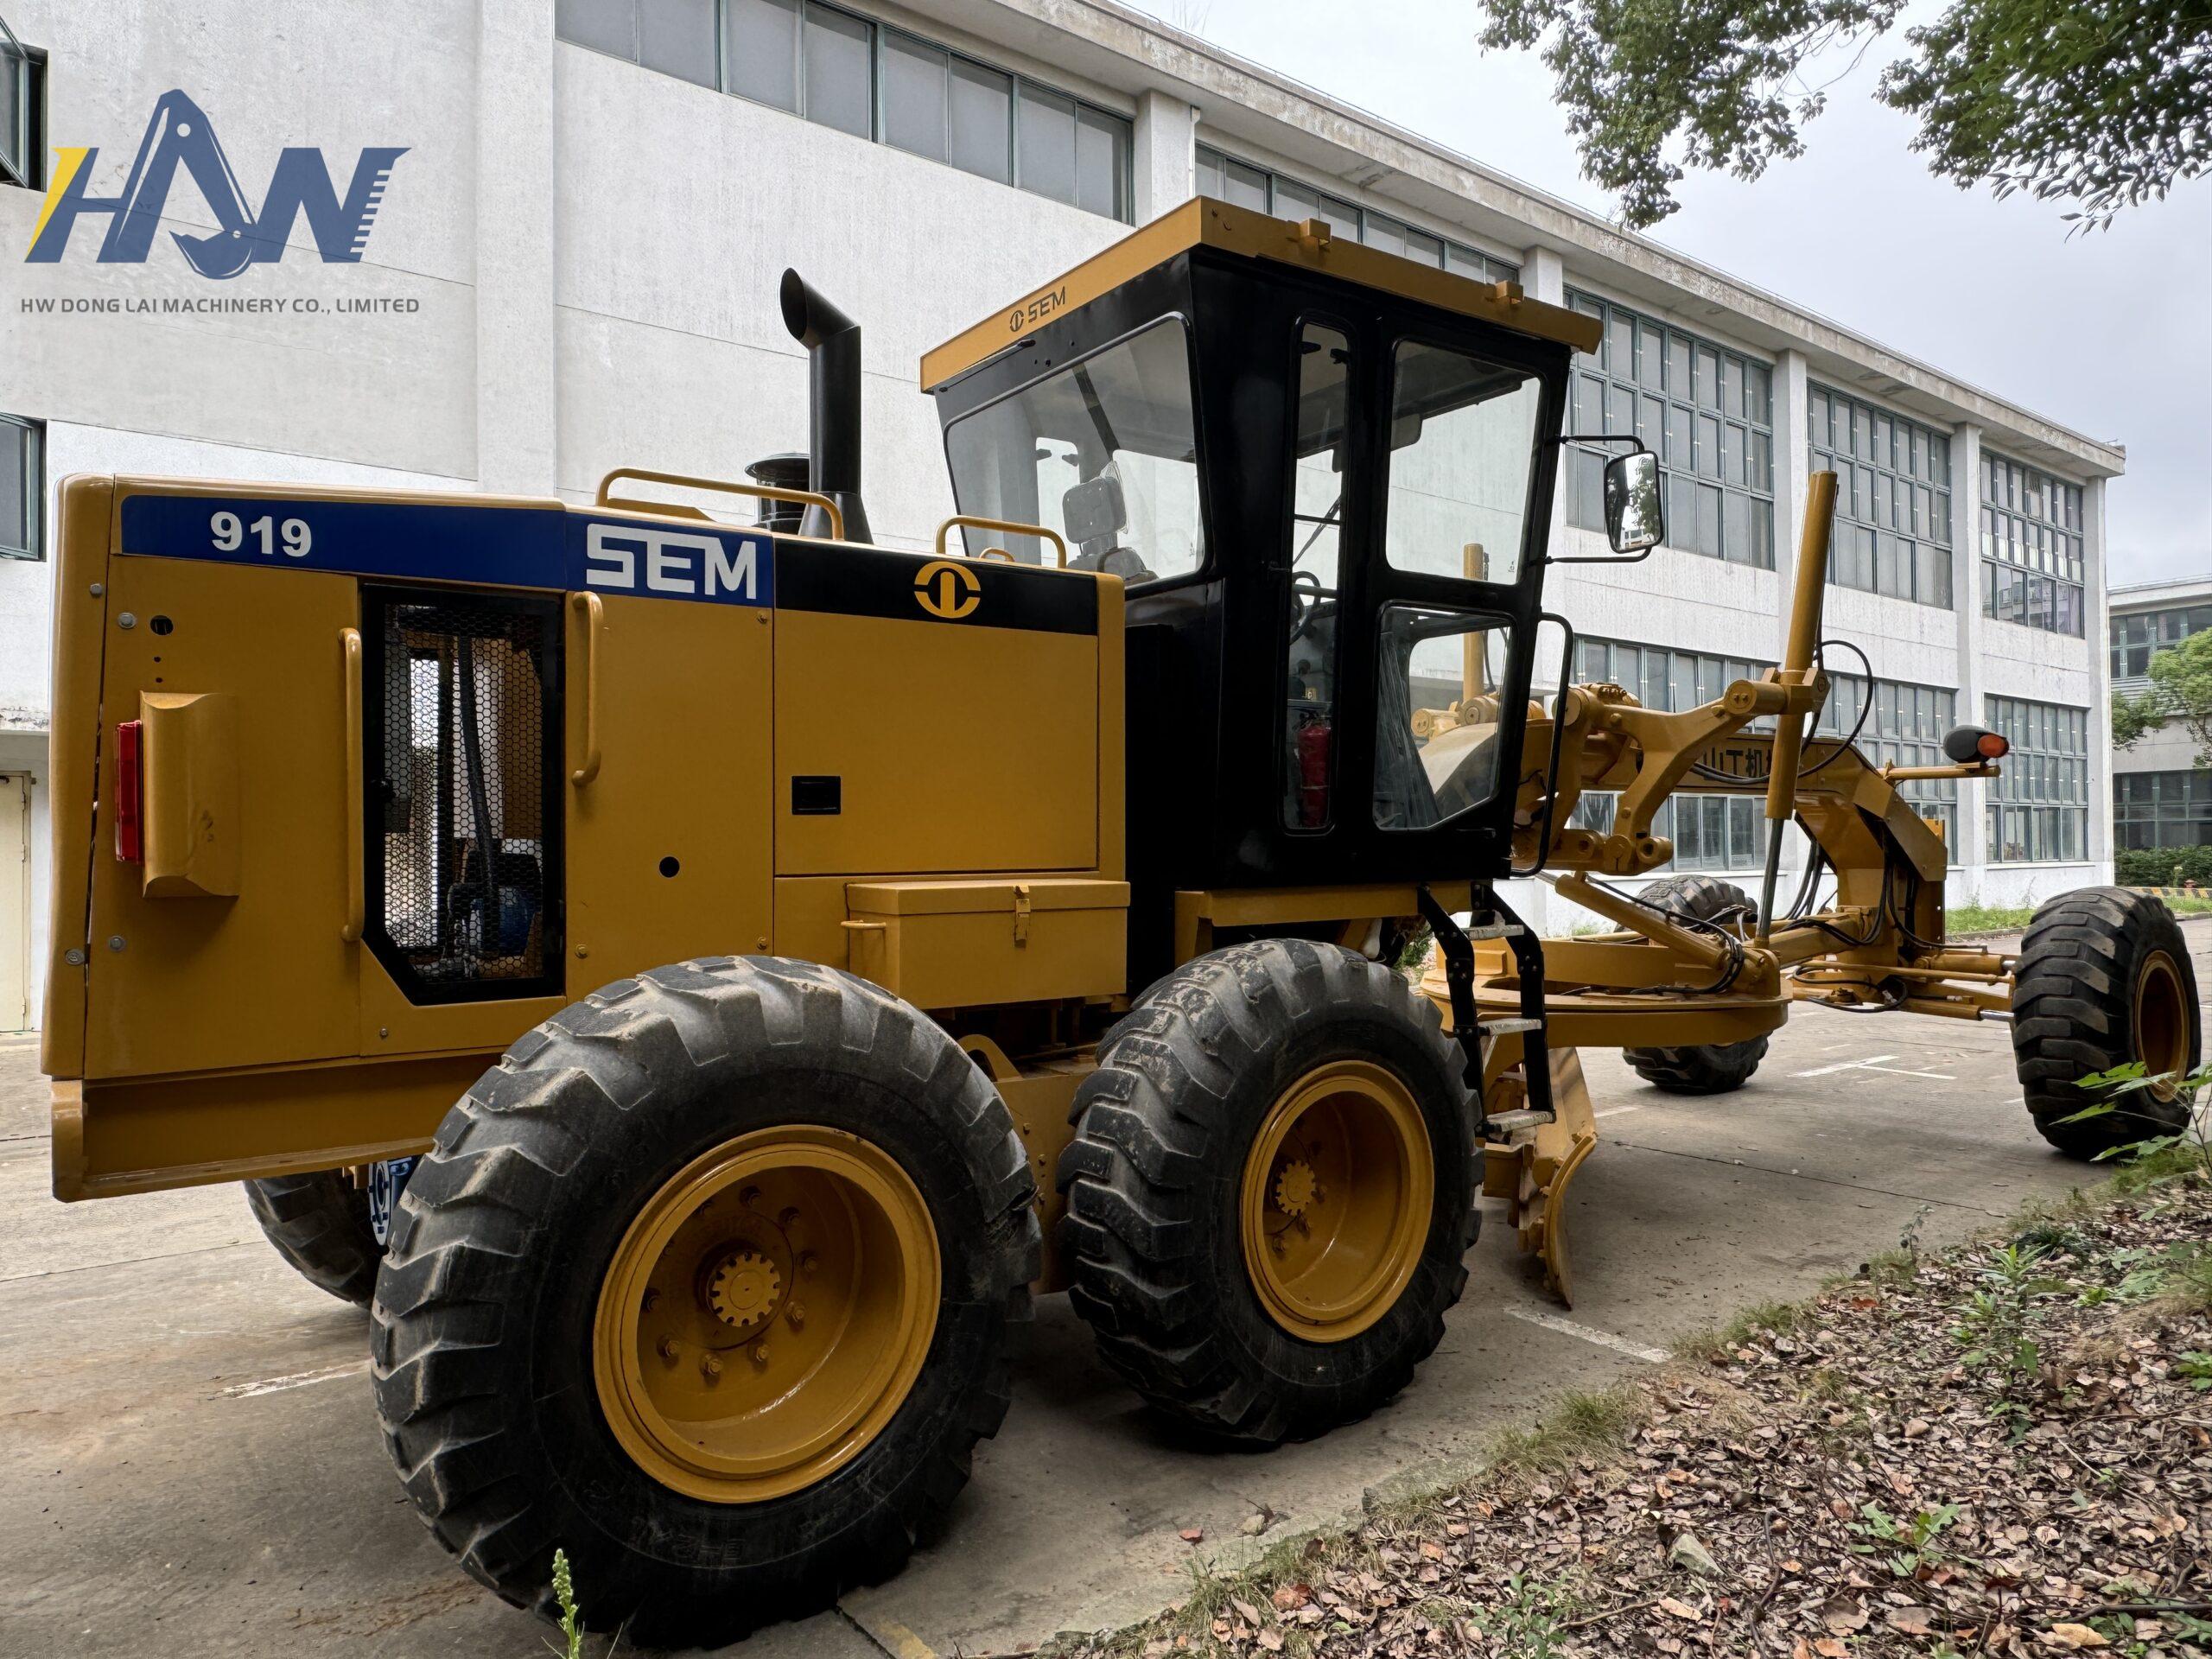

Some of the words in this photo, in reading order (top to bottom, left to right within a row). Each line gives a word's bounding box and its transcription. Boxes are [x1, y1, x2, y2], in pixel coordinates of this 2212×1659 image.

[1028, 286, 1065, 323] SEM
[210, 511, 312, 557] 919
[586, 523, 757, 600] SEM
